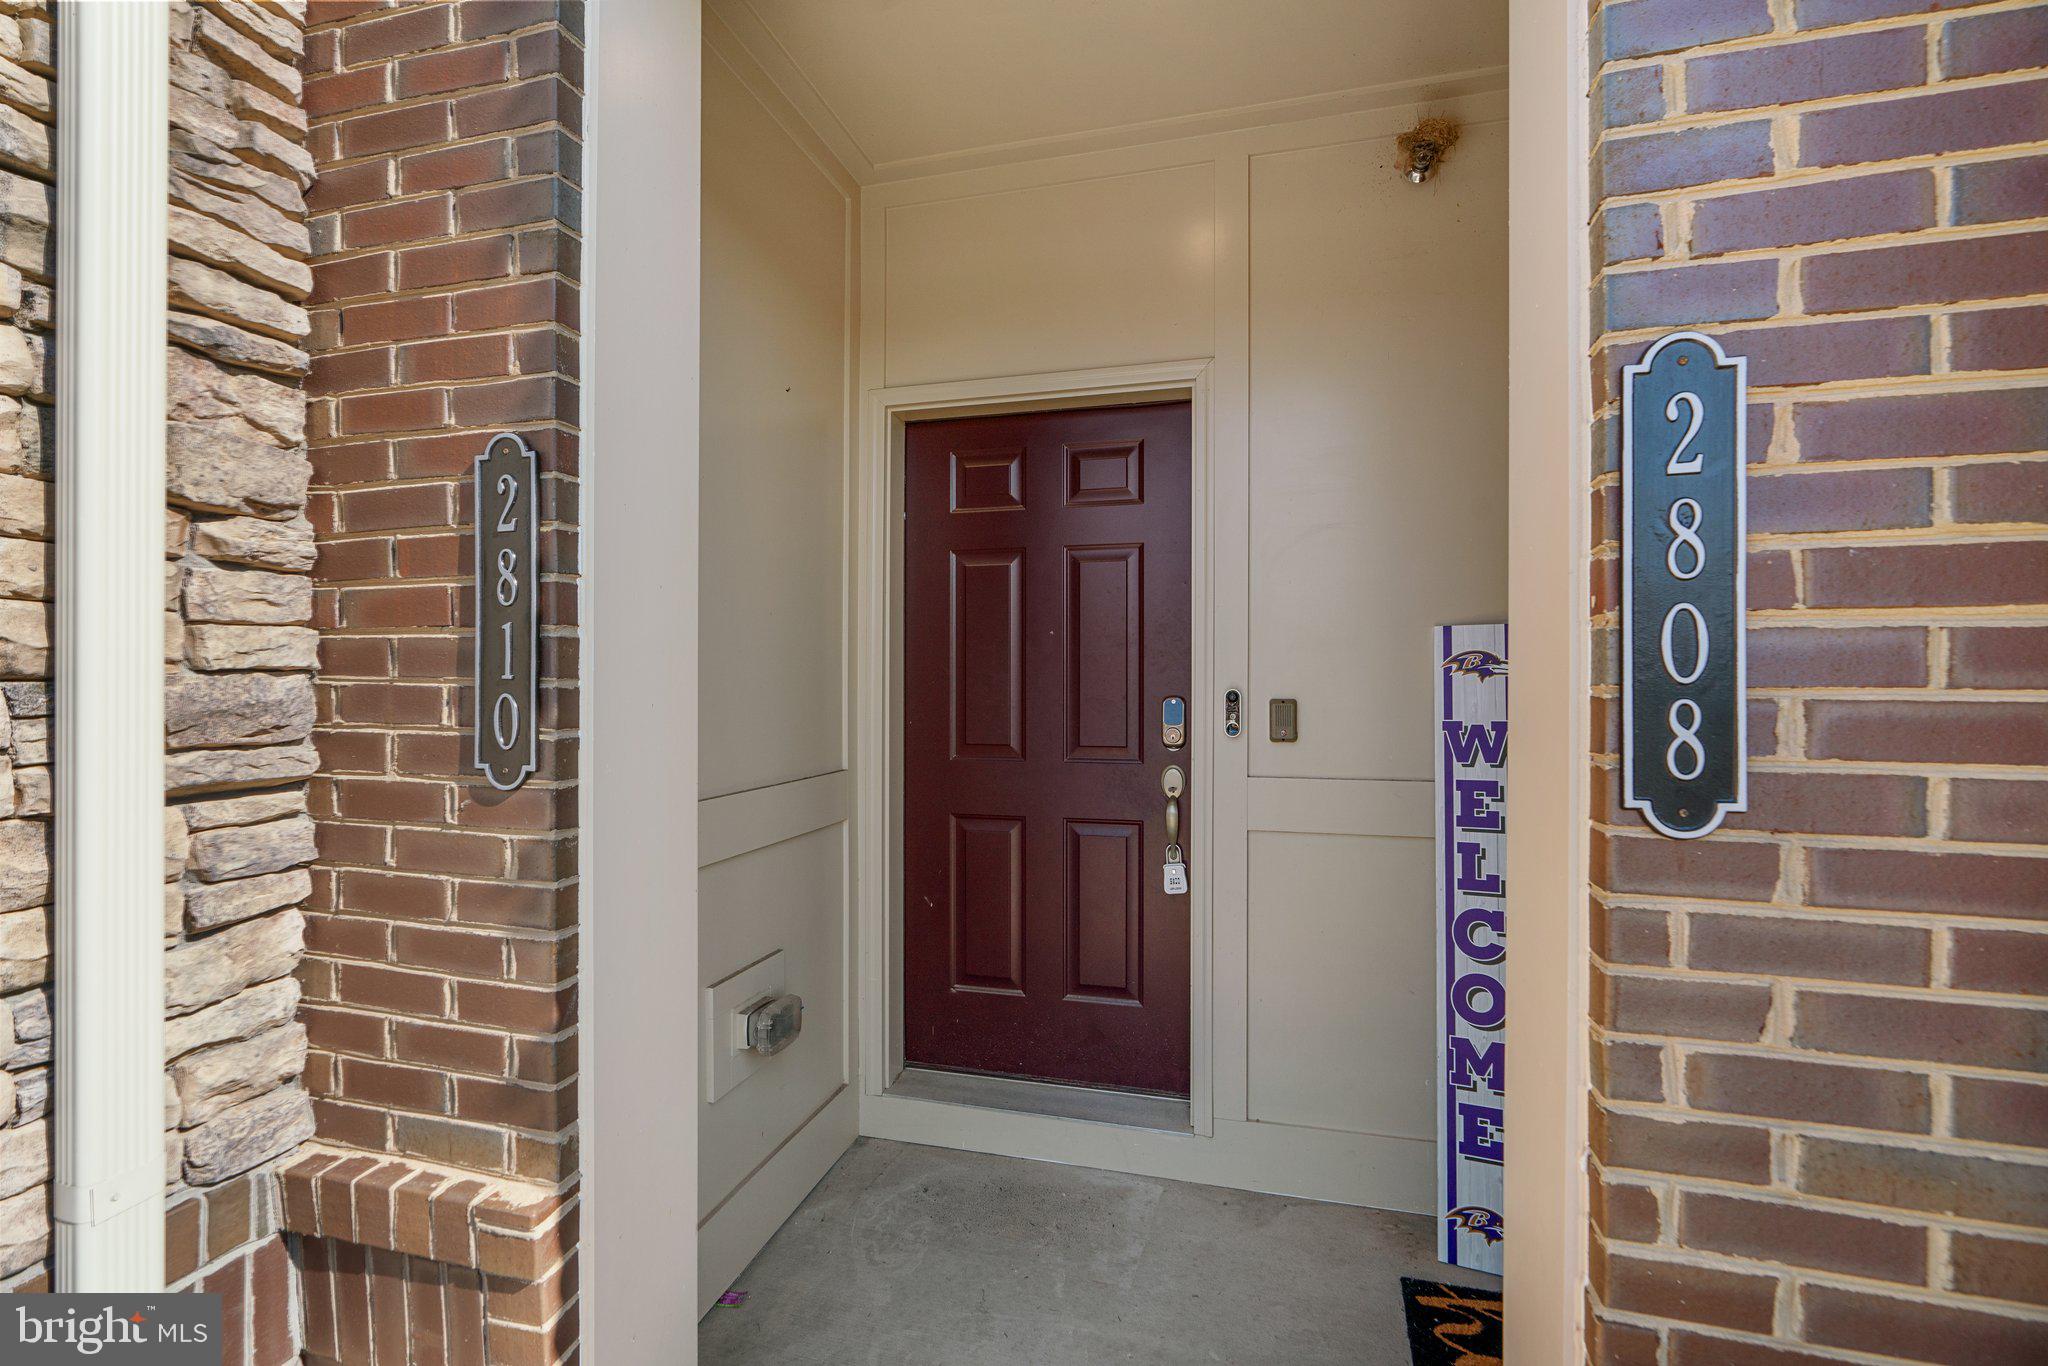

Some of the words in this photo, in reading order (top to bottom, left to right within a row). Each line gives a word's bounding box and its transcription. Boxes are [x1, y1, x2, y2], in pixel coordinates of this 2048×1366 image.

[493, 473, 520, 750] 2810
[1661, 391, 1710, 781] 2808
[1442, 720, 1508, 1164] WELCOME
